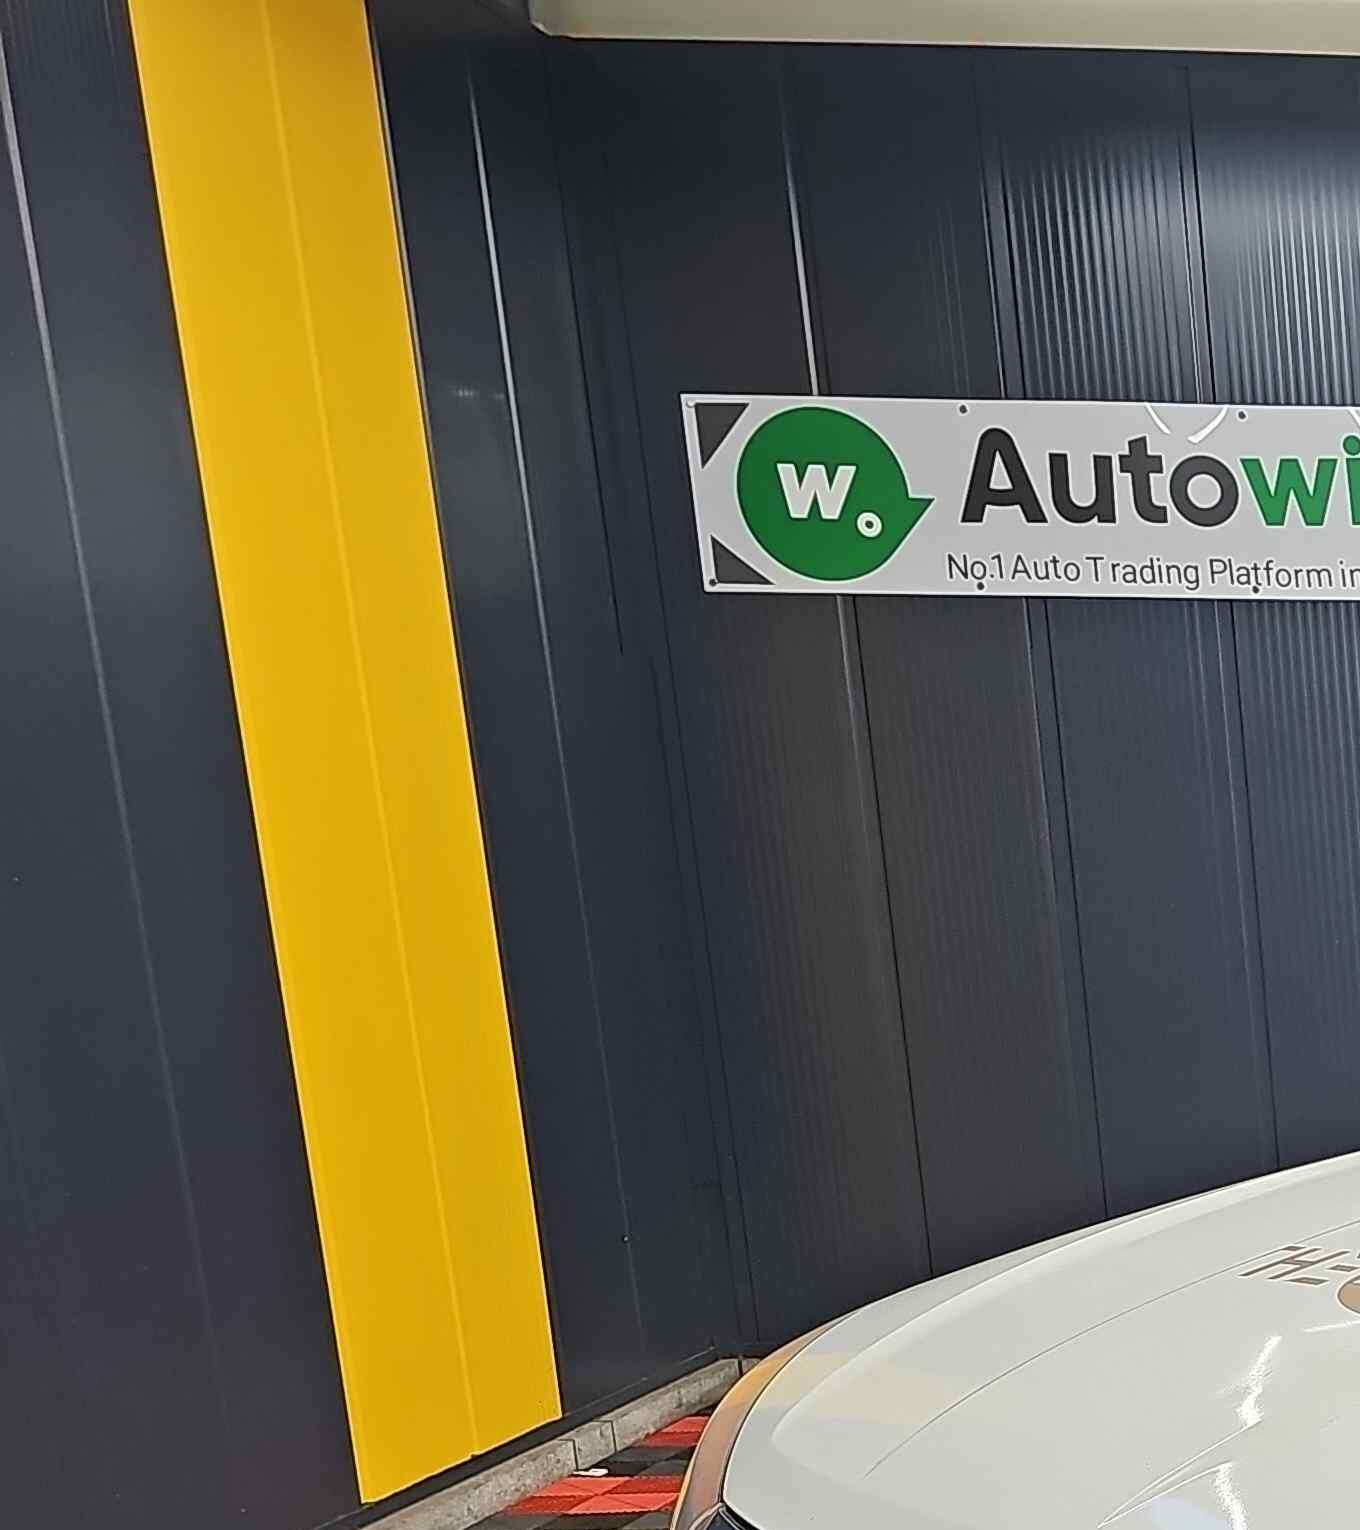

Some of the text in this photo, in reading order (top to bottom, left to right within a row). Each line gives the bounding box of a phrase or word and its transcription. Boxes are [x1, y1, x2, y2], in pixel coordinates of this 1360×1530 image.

[947, 553, 1005, 581] No.1
[1010, 554, 1082, 583] Auto
[1208, 557, 1334, 588] Platform
